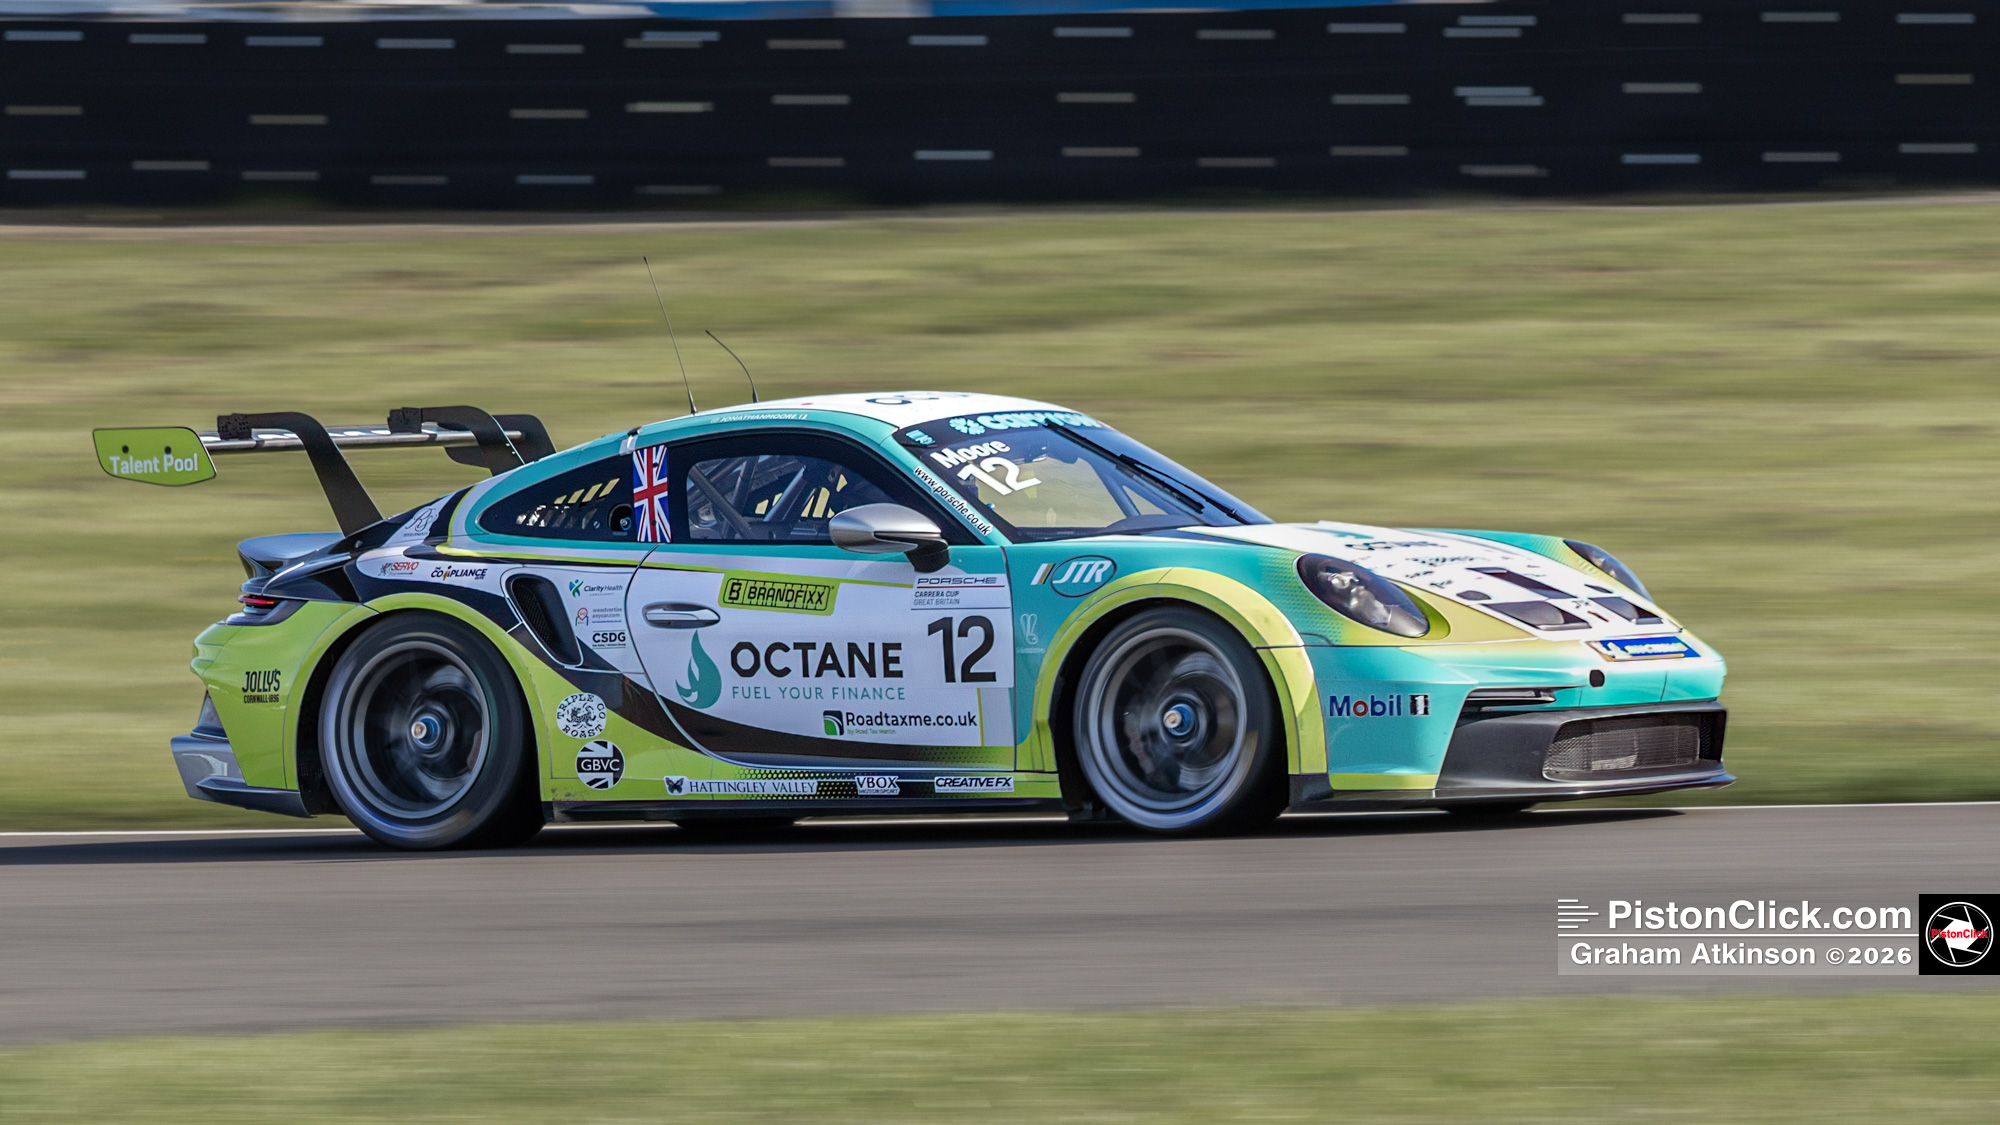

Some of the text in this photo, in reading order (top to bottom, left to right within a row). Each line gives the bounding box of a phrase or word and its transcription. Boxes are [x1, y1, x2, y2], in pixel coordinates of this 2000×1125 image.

[930, 440, 1010, 469] Moore
[109, 452, 198, 475] Talent Pool
[957, 456, 1042, 496] 12
[914, 466, 993, 536] www.porsche.co.uk
[1052, 560, 1113, 584] JTR
[917, 577, 998, 585] PORSCHE
[747, 586, 825, 605] BRANDFIXX
[935, 598, 961, 606] BRITAIN
[592, 632, 626, 643] CSDG
[927, 615, 997, 683] 12
[730, 641, 904, 678] OCTANE
[732, 686, 906, 700] FUEL YOUR FINANCE
[556, 694, 607, 720] TRIPLE CO
[1329, 695, 1402, 717] Mobil
[845, 711, 978, 727] Roadtaxme.co.uk
[562, 724, 603, 738] ROAST
[581, 759, 620, 771] GBVC
[689, 781, 816, 793] HATTINGLEY VALLEY
[856, 777, 897, 788] VBOX
[935, 777, 1011, 788] CREATIVE FX
